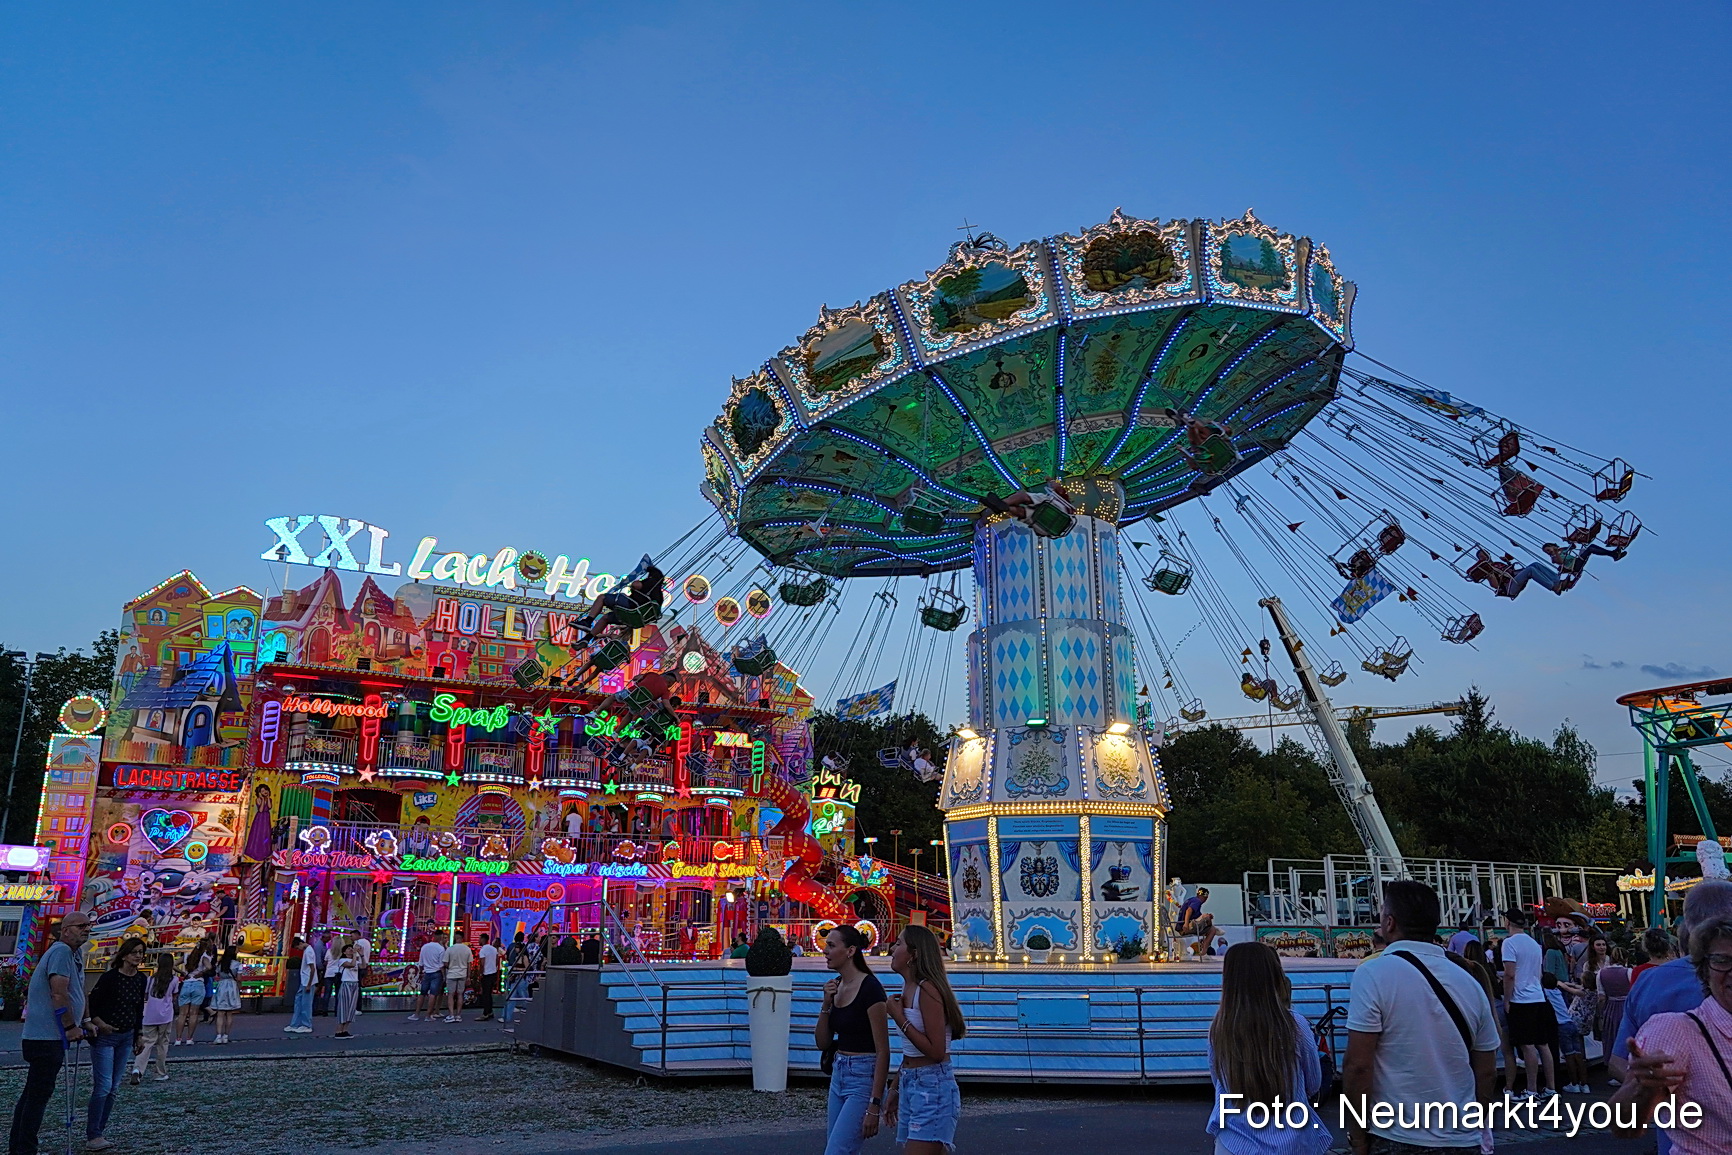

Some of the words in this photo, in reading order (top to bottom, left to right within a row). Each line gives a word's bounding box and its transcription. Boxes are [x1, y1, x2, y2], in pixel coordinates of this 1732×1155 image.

[261, 514, 401, 577] XXL
[407, 536, 517, 590] Lach
[282, 697, 388, 718] Hollywood
[430, 694, 509, 732] Spaß
[713, 731, 753, 748] XXL
[117, 768, 240, 790] LACHSTRASSE
[331, 851, 371, 868] Time
[400, 854, 461, 872] Zauber
[543, 860, 587, 877] Super
[590, 862, 649, 878] Rutsche
[672, 862, 714, 878] Gaudi
[719, 862, 756, 878] Show
[7, 886, 44, 900] HAUS
